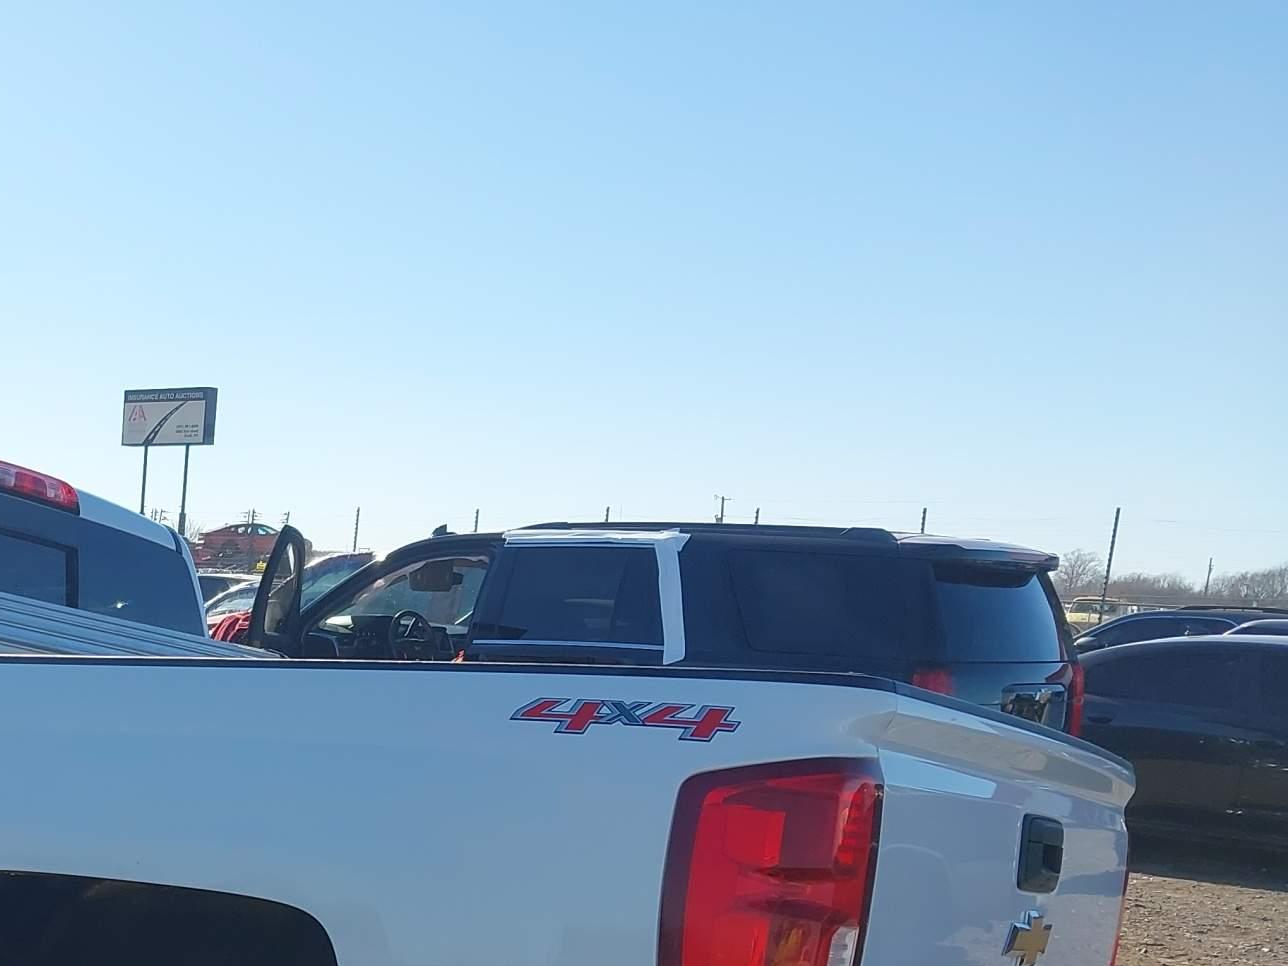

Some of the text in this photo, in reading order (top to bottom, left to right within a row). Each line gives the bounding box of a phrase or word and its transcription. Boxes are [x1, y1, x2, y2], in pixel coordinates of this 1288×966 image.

[127, 391, 204, 400] INSURANCE AUTO AUCTIONS
